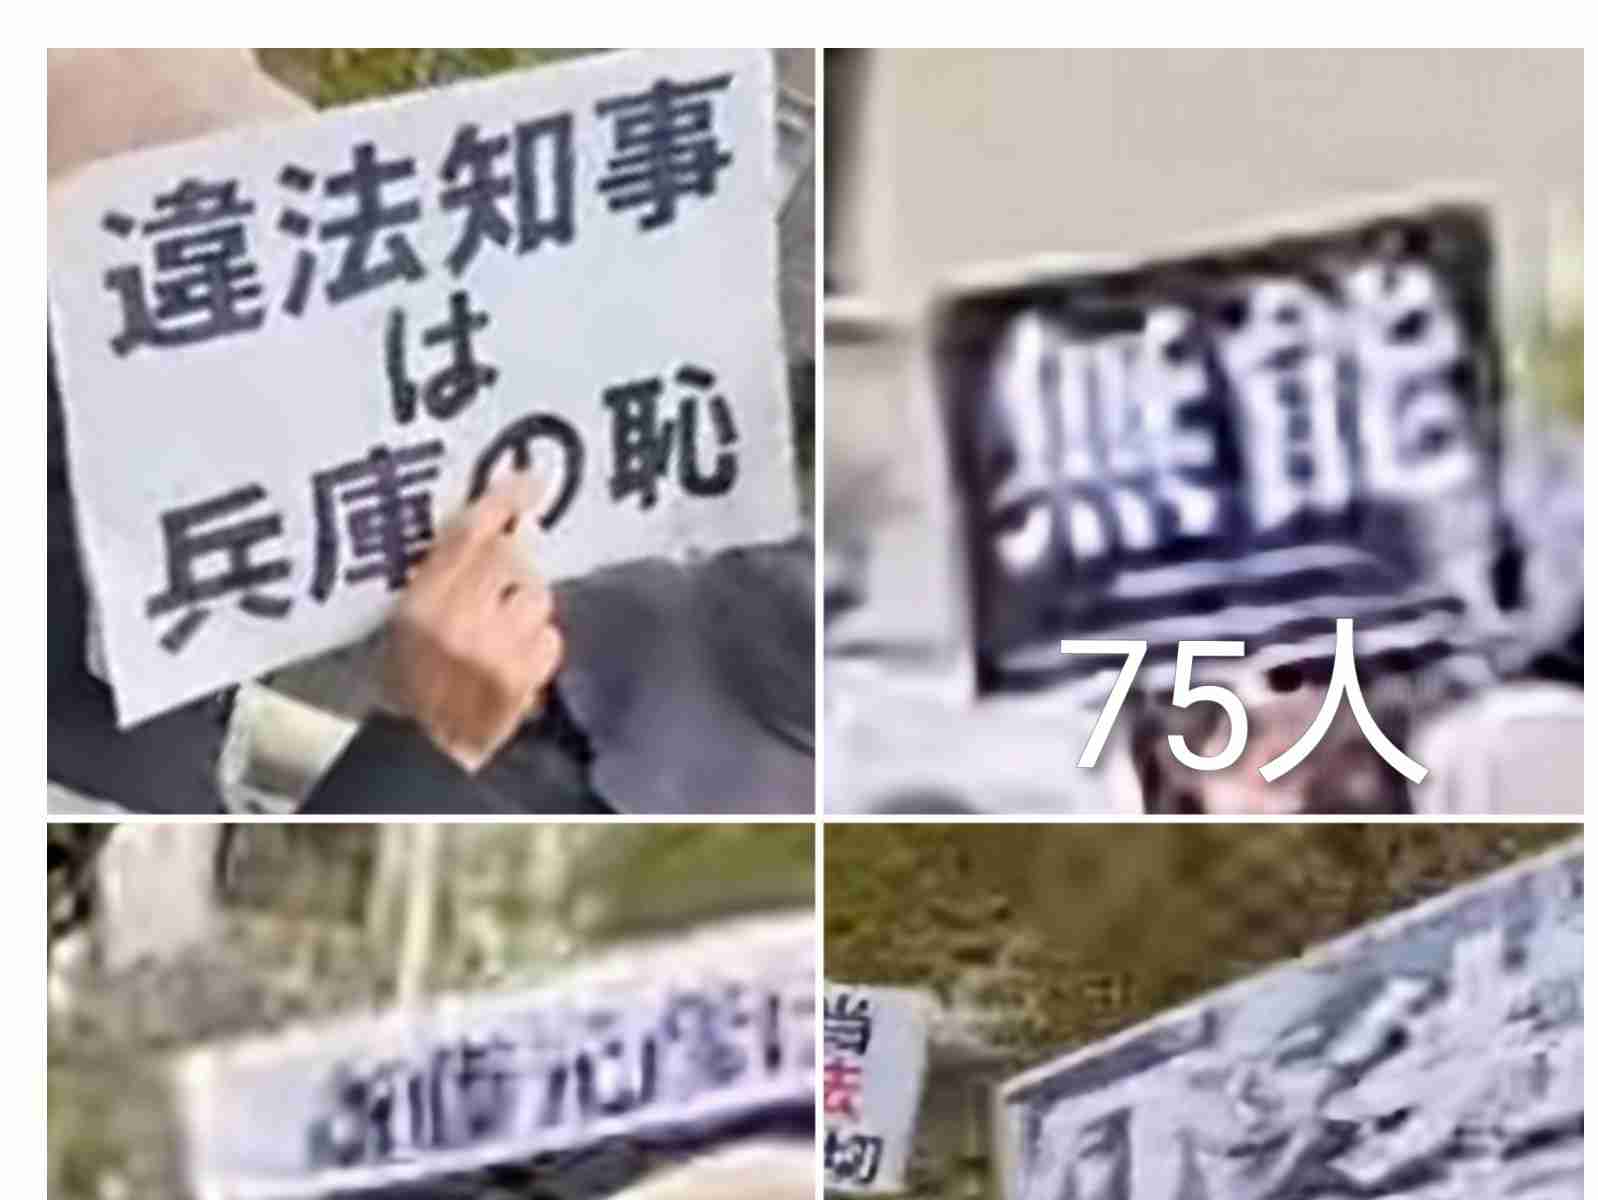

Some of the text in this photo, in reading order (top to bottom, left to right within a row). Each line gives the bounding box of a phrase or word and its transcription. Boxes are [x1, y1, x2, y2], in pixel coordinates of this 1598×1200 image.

[102, 70, 736, 358] 違法知事
[385, 288, 500, 426] は
[145, 364, 740, 655] 兵庫の恥
[992, 258, 1482, 578] 無能
